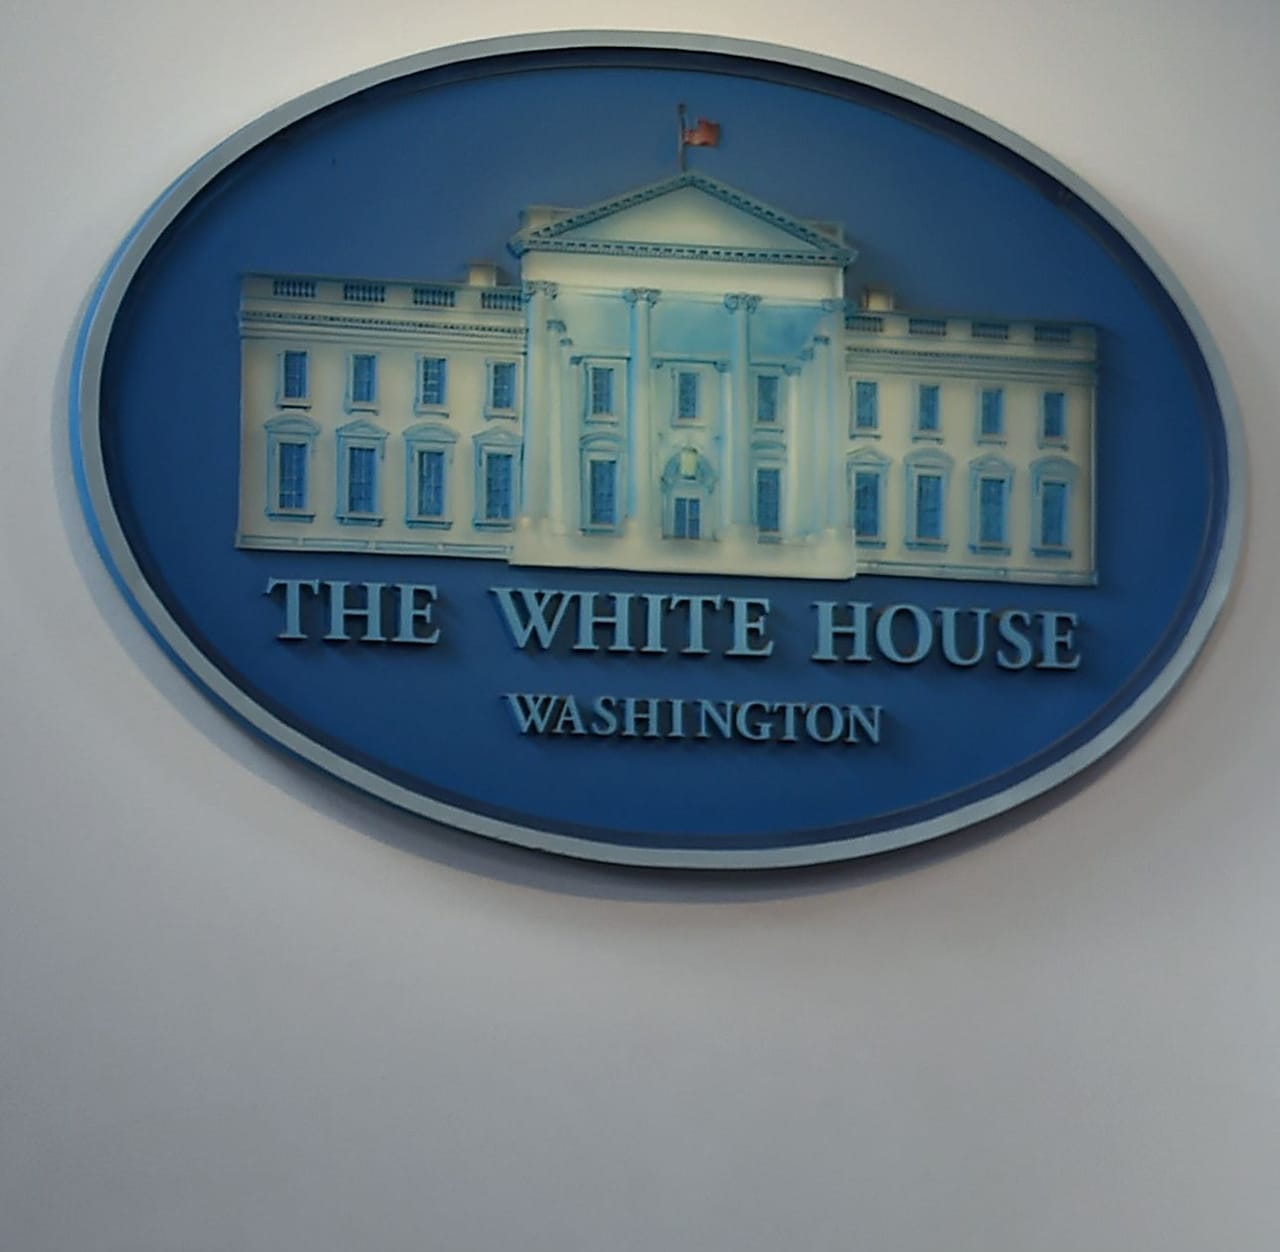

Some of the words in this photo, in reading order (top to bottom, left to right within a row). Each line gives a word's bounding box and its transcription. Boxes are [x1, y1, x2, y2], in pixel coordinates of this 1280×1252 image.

[266, 577, 440, 645] THE
[489, 586, 775, 658] WHITE
[810, 601, 1082, 670] HOUSE
[501, 693, 884, 744] WASHINGTON
